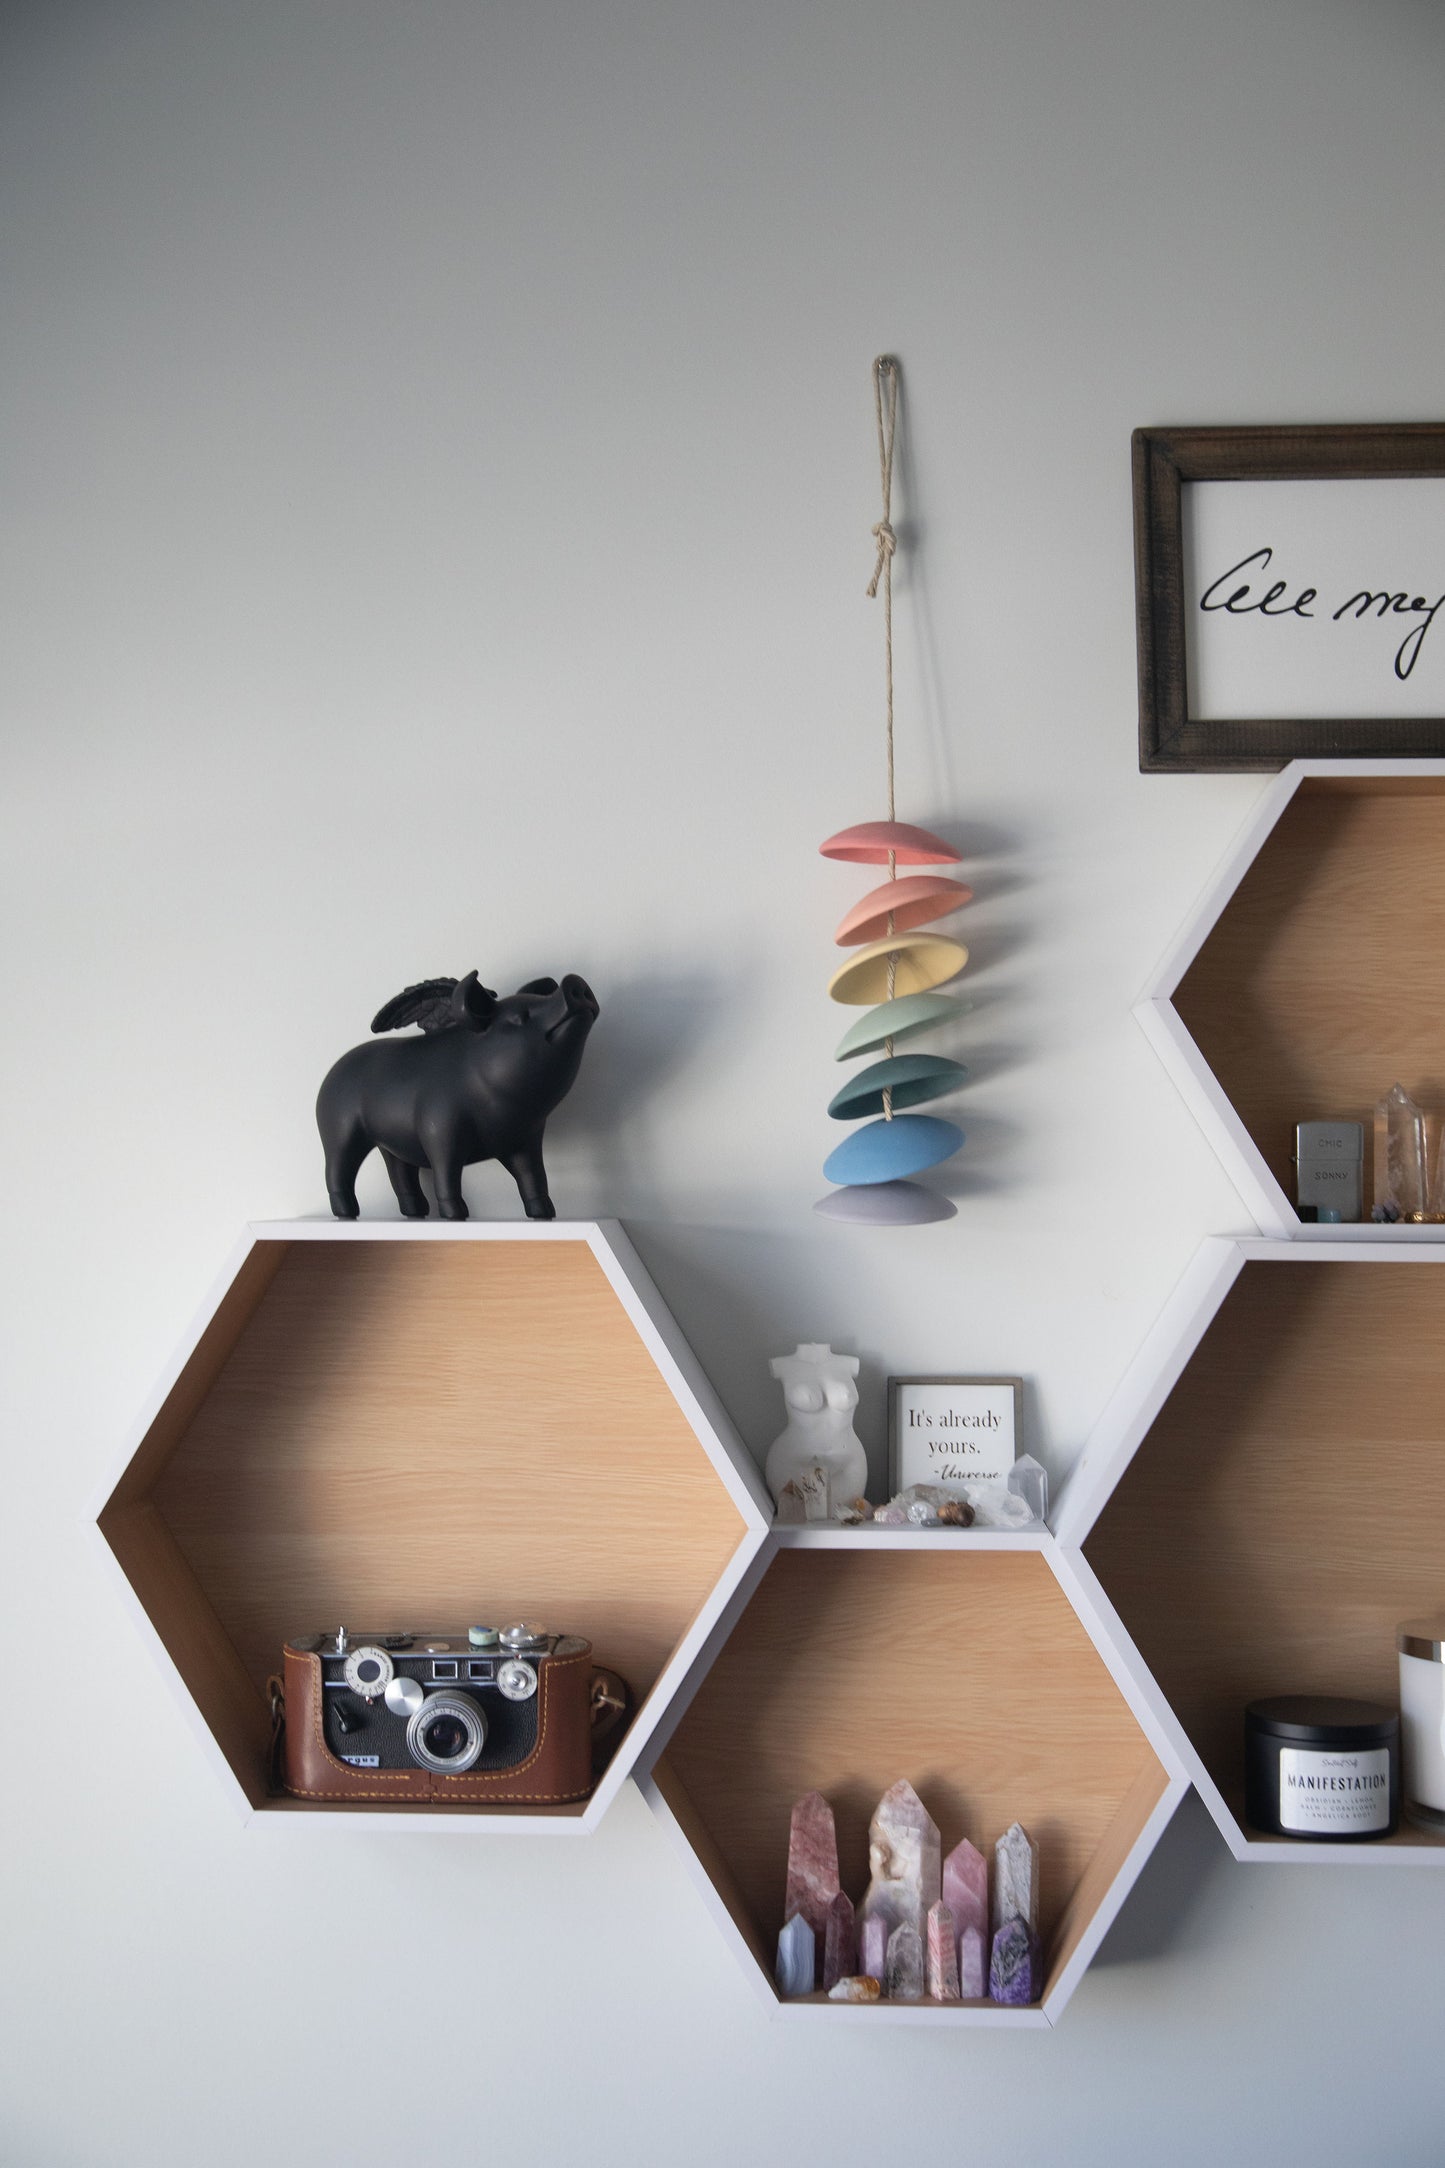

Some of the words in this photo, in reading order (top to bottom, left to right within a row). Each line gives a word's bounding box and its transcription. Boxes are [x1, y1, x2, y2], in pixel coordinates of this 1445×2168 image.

[1333, 591, 1445, 680] my
[1314, 1170, 1349, 1181] SONNY
[908, 1408, 933, 1427] It's
[939, 1409, 1002, 1432] already
[928, 1441, 981, 1458] yours.
[1288, 1773, 1385, 1791] MANIFESTATION
